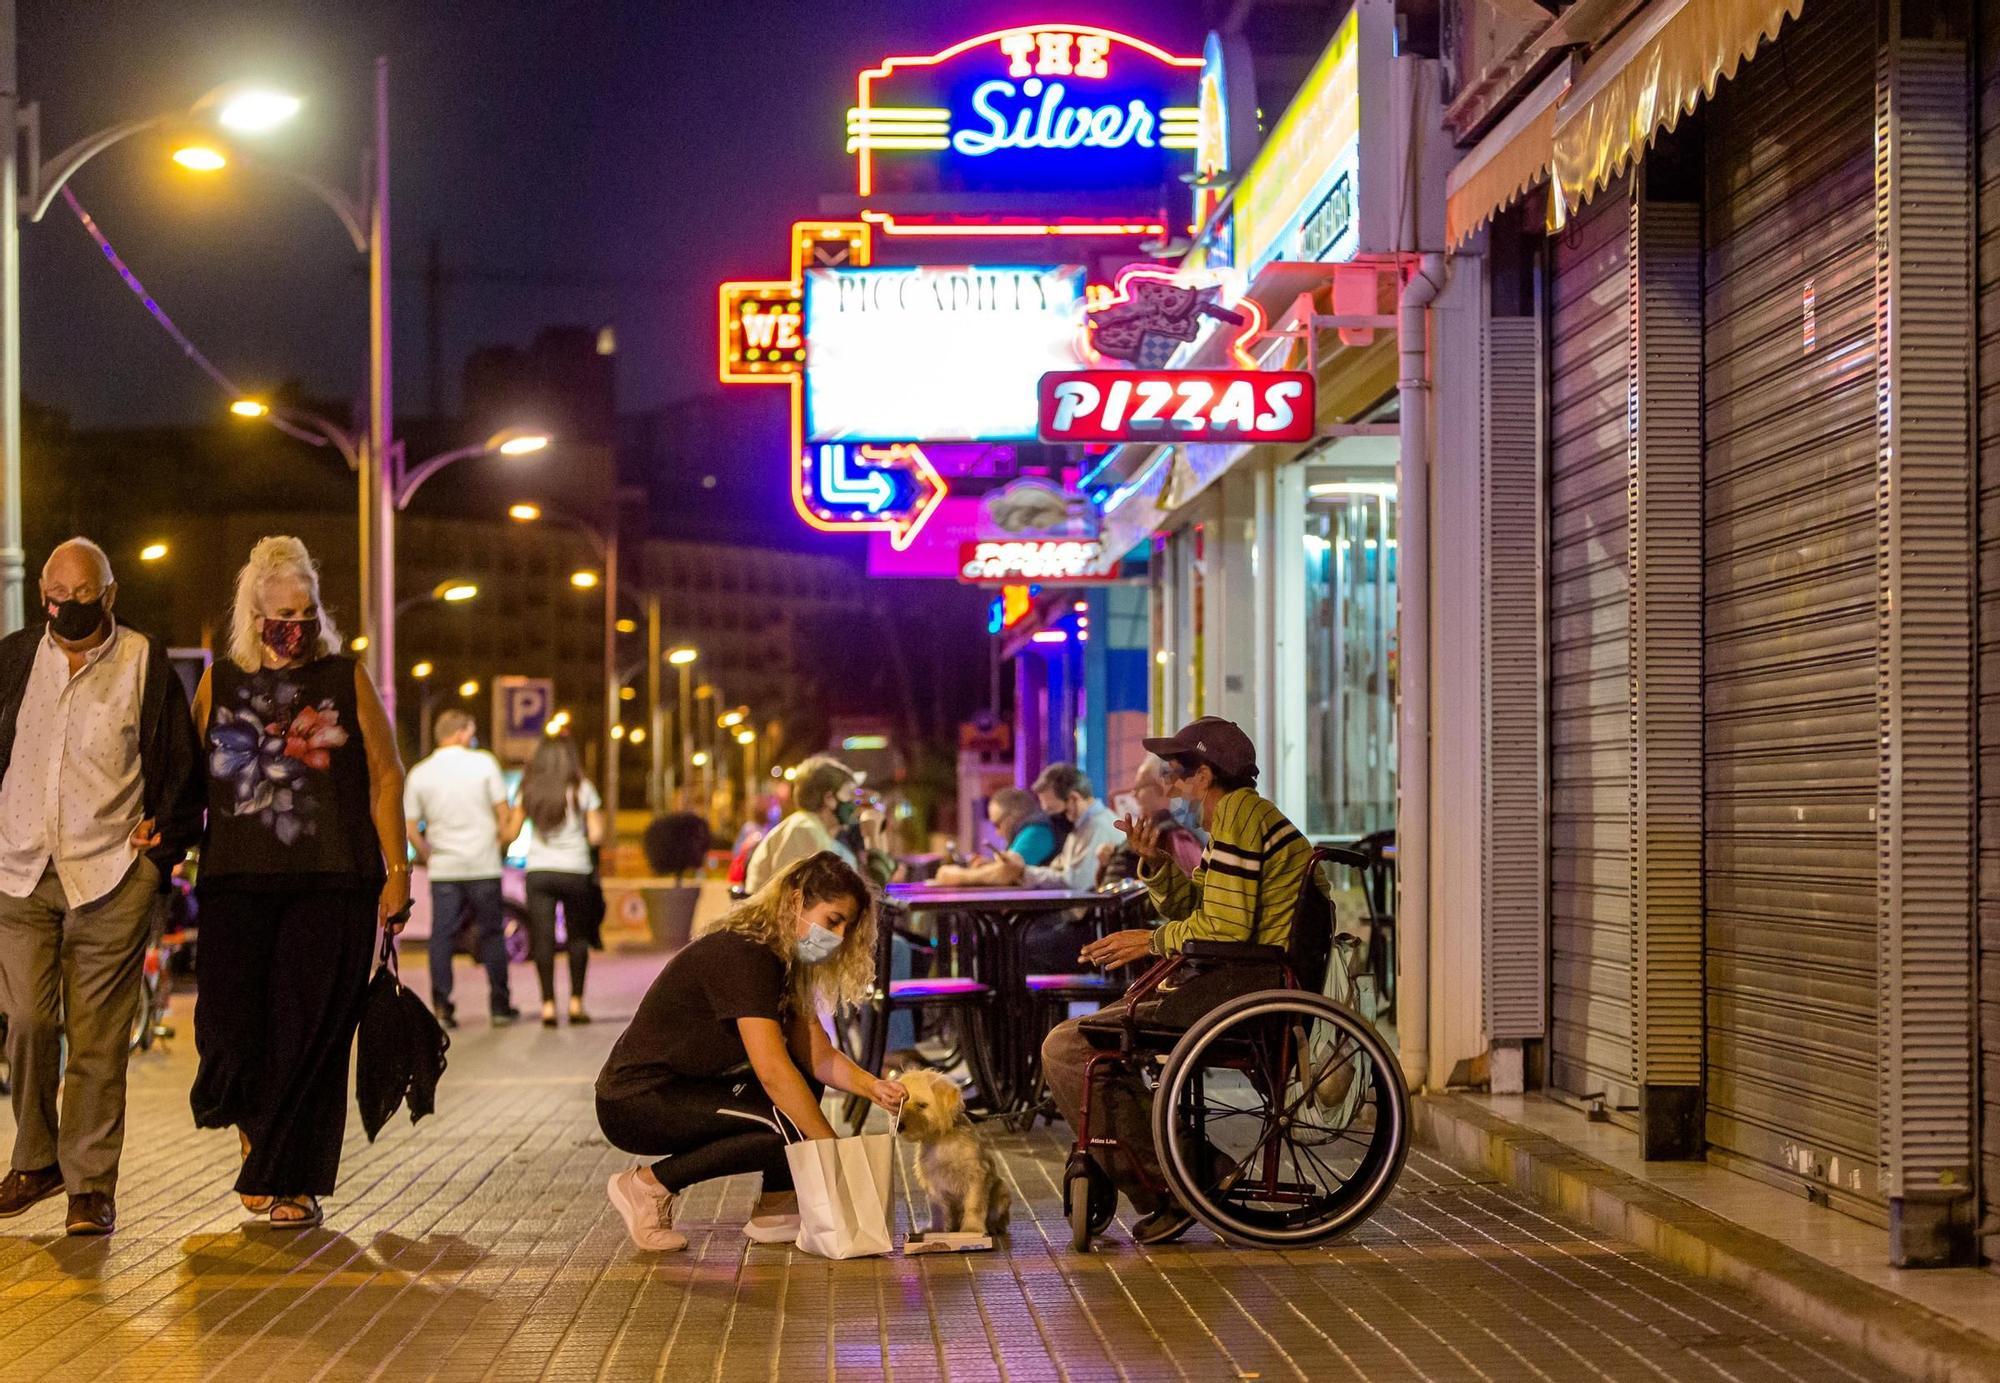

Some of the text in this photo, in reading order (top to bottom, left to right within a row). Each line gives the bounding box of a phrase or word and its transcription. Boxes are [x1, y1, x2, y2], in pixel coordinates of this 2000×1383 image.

[1000, 32, 1110, 79] THE
[953, 77, 1156, 156] Silver
[1052, 380, 1302, 432] PIZZAS
[513, 690, 542, 727] P
